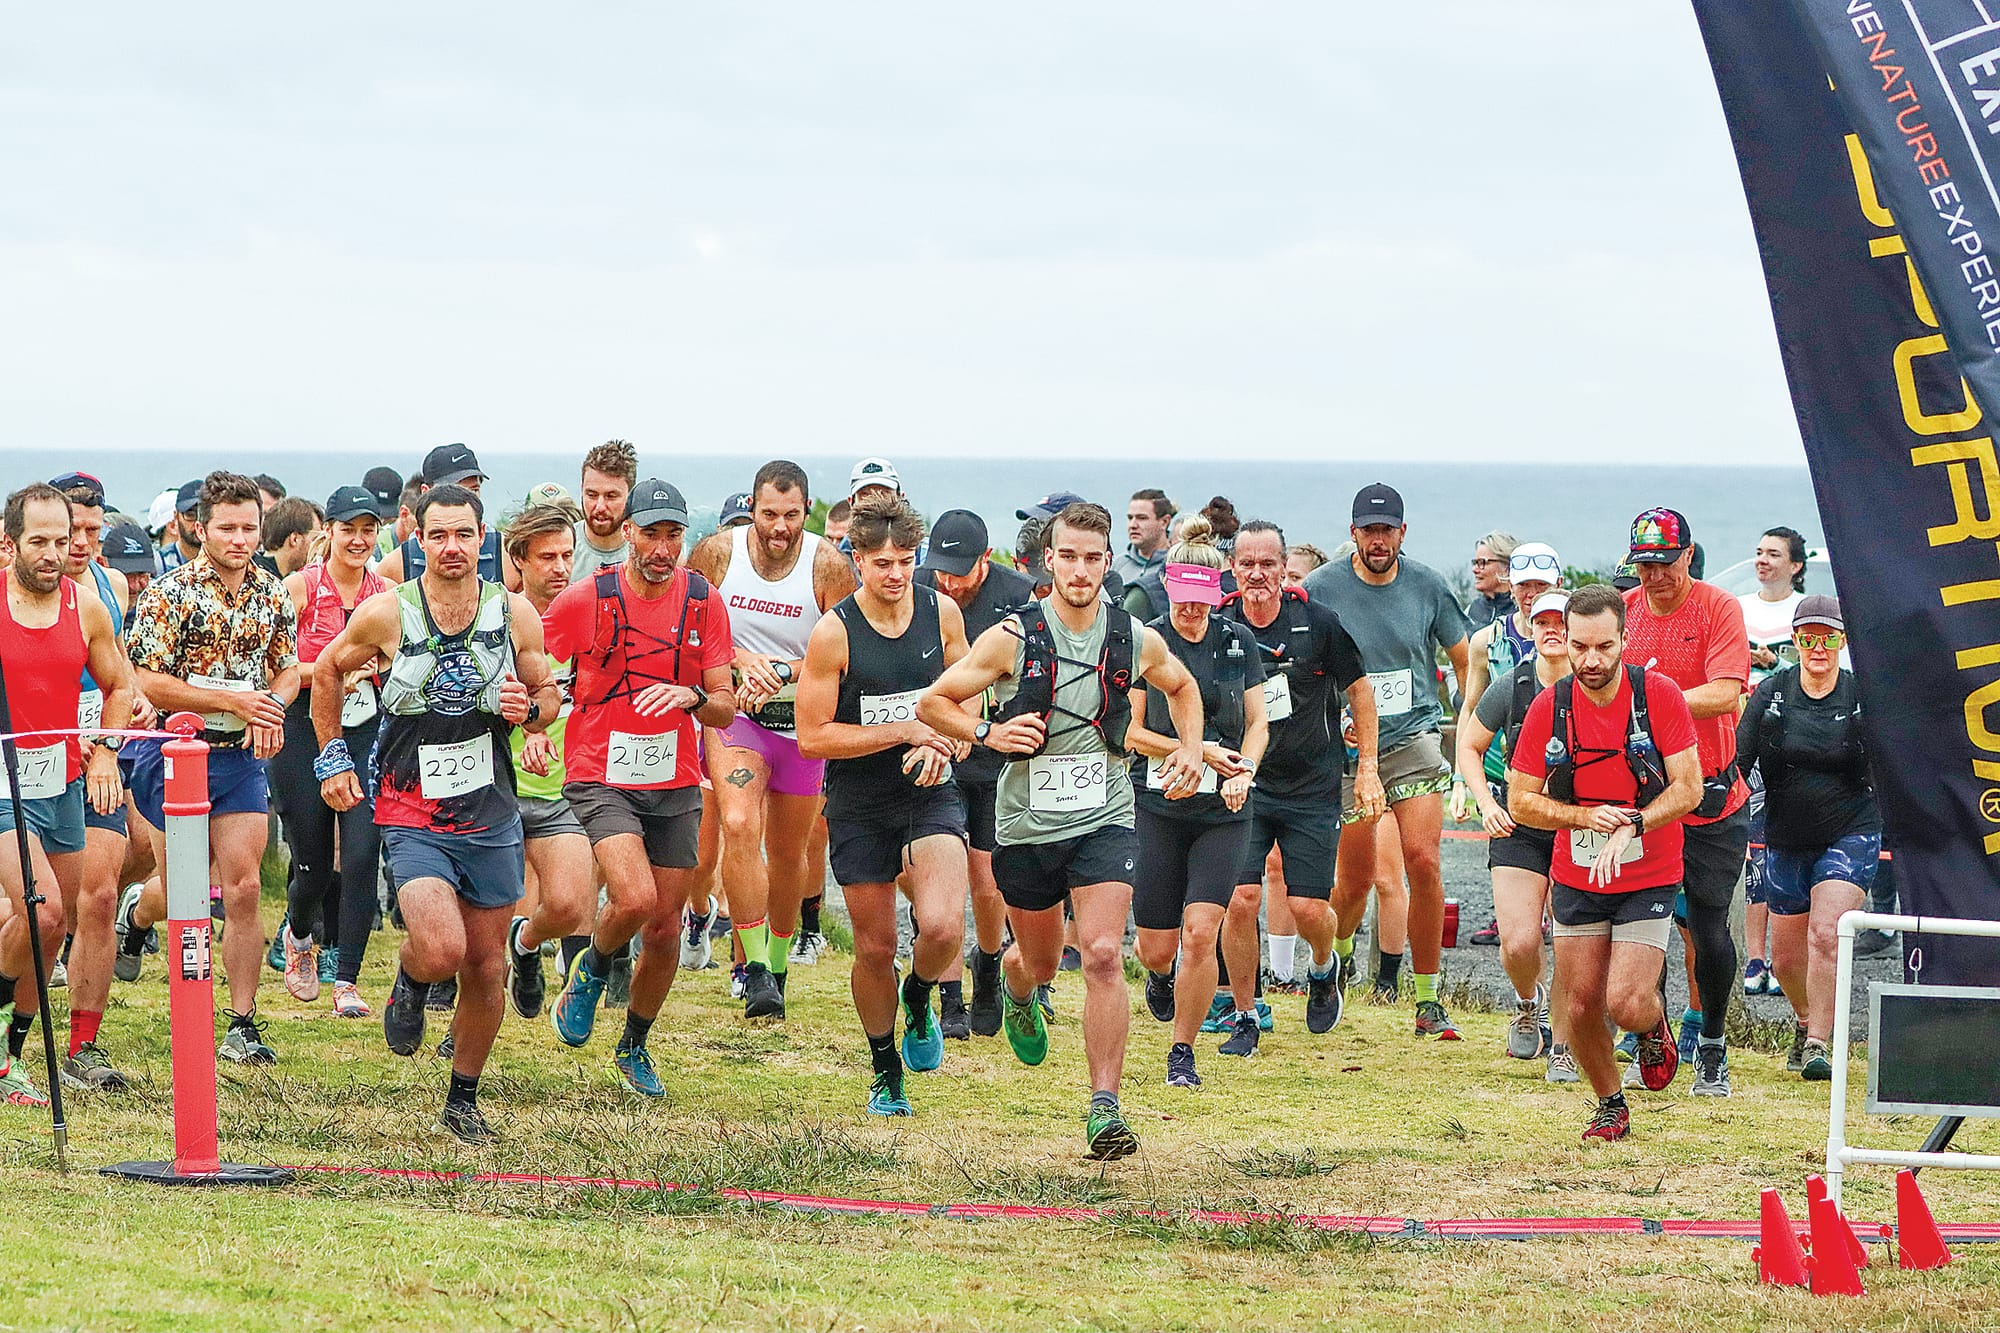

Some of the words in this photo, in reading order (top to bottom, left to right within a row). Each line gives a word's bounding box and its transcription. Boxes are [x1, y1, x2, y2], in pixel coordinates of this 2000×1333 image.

[730, 594, 803, 618] CLOGGERS
[760, 720, 797, 730] NATHA
[863, 701, 917, 726] 220
[426, 749, 485, 777] 2201
[613, 745, 674, 767] 2184
[1033, 762, 1104, 791] 2188
